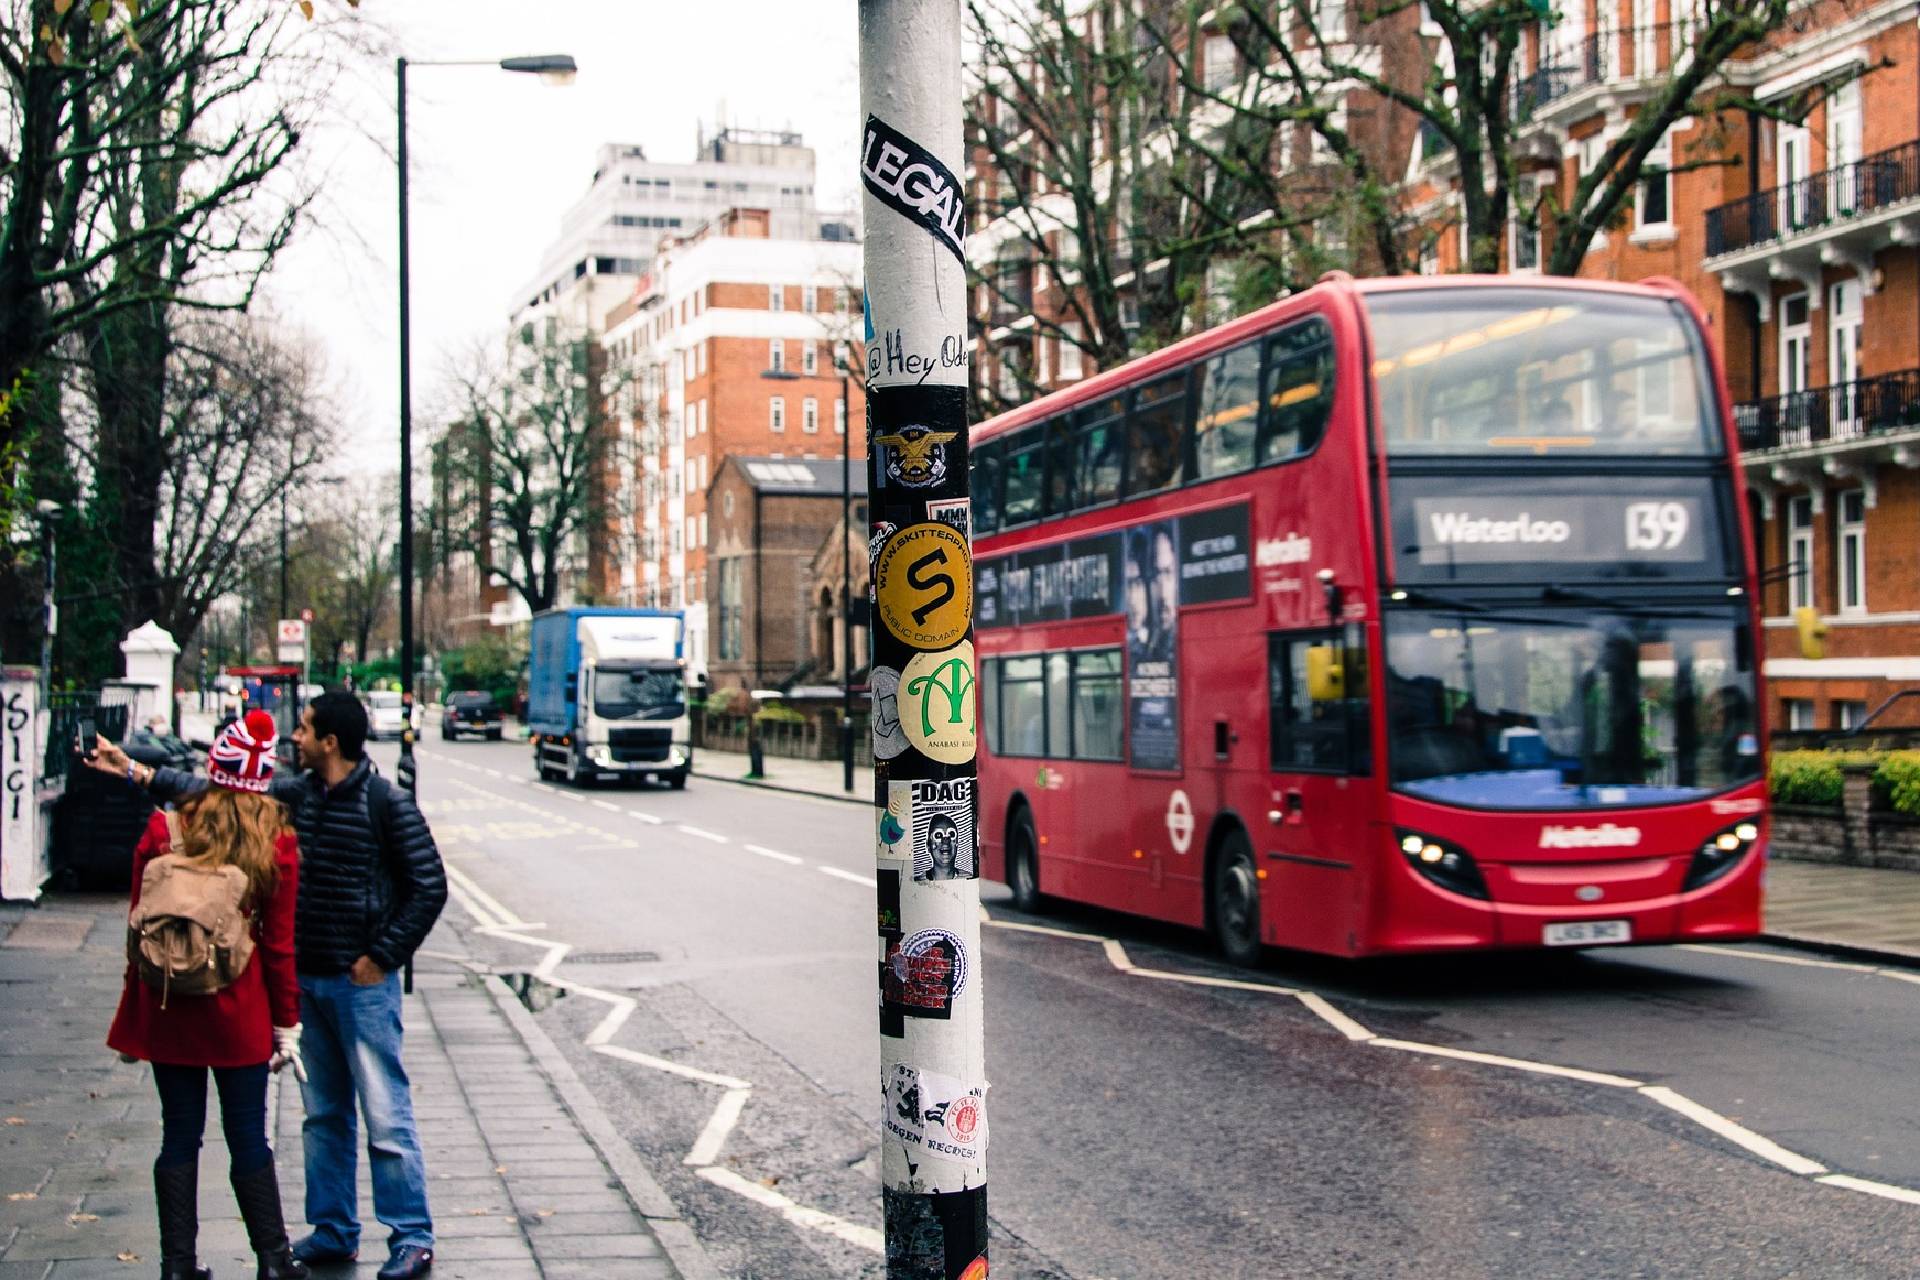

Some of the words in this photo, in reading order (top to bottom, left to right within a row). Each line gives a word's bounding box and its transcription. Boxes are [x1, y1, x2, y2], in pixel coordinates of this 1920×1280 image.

[1429, 512, 1571, 544] Waterloo
[1625, 502, 1690, 551] 139
[883, 604, 911, 638] PUBLIC
[914, 626, 960, 643] DOMAIN
[921, 782, 966, 802] DAG
[888, 1120, 923, 1144] GEGEN
